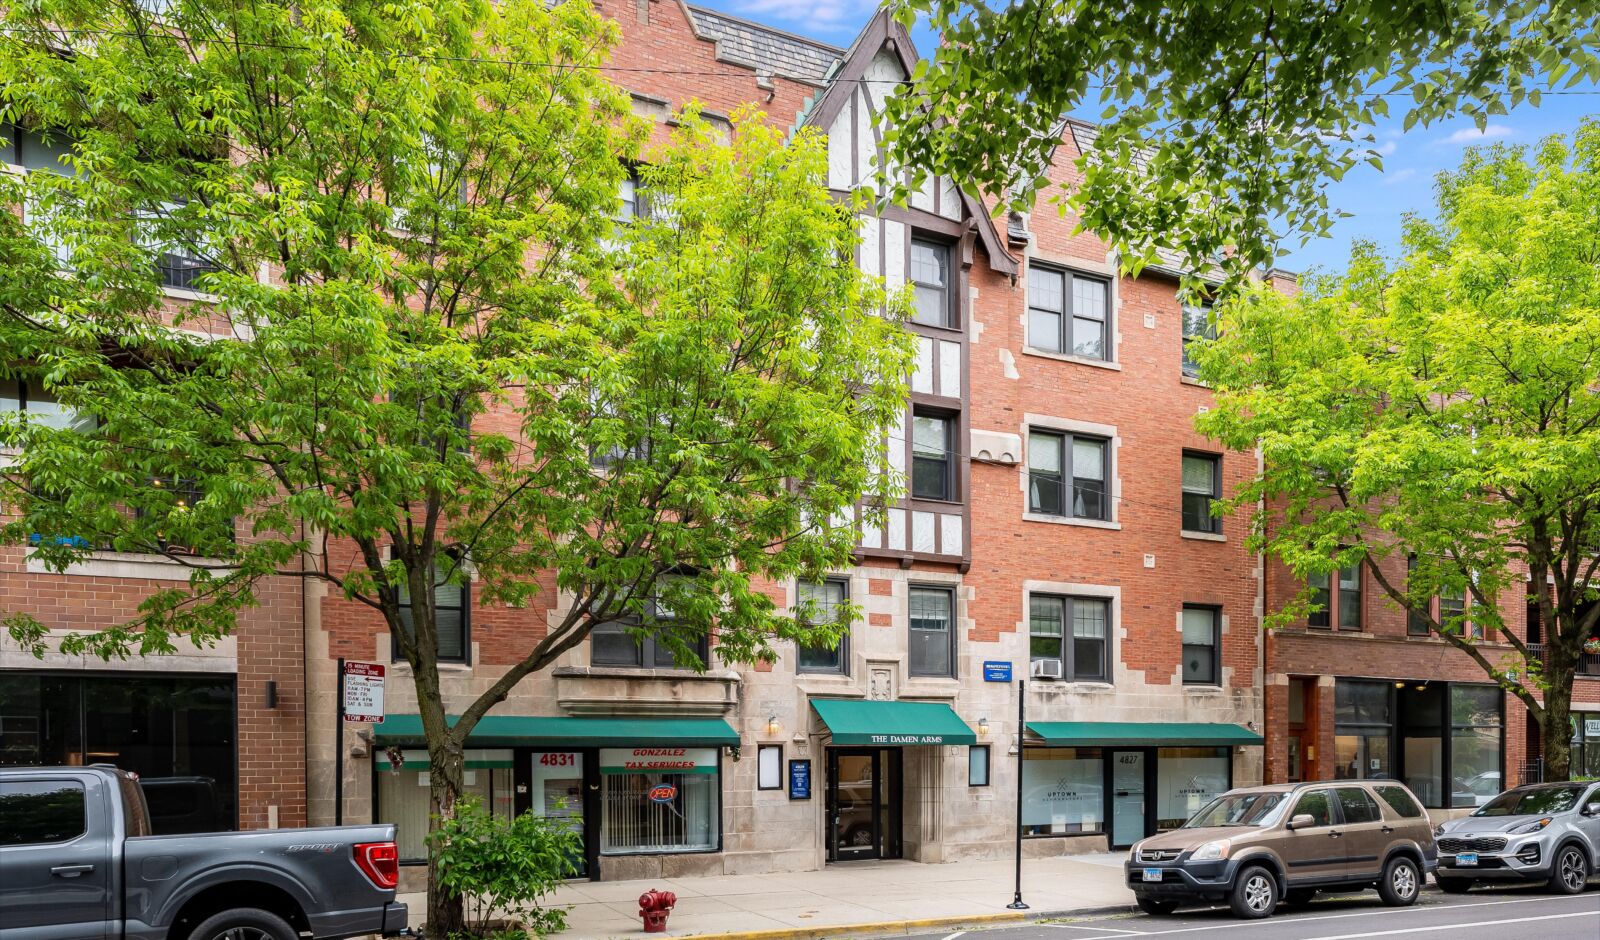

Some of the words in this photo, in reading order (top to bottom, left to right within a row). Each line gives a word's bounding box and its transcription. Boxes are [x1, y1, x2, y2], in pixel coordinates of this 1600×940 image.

[871, 735, 888, 743] THE
[890, 735, 919, 743] DAMEN
[633, 749, 687, 757] GONZALEZ
[540, 753, 575, 766] 4831
[1120, 755, 1138, 765] 4827
[625, 761, 646, 769] TAX
[647, 761, 695, 769] SERVICES
[650, 787, 676, 799] OPEN
